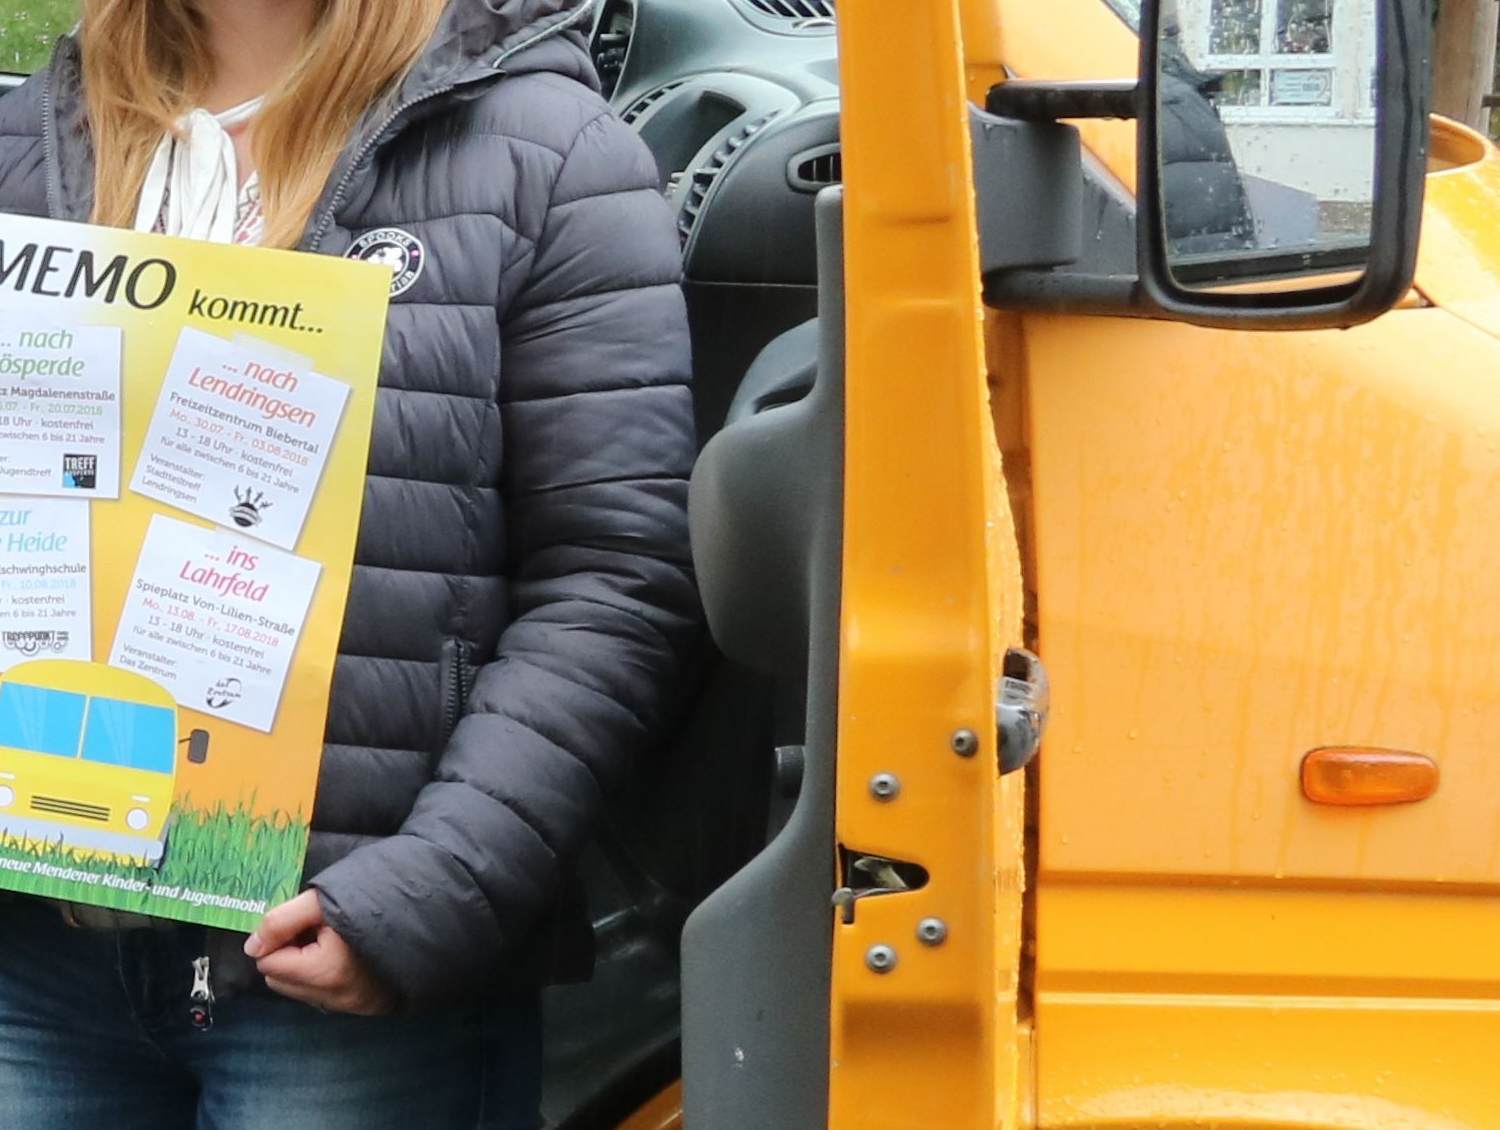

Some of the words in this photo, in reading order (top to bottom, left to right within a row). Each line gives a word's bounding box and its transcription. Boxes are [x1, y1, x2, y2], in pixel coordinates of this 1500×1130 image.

[359, 231, 414, 248] SPOOKS
[187, 288, 325, 333] kommt...
[18, 328, 73, 349] nach
[243, 360, 299, 393] nach
[10, 385, 115, 401] Magdalenenstraße
[186, 366, 316, 430] Lendringsen
[47, 403, 102, 415] 20.07.2018
[169, 391, 263, 434] Freizeitzentrum
[264, 426, 319, 454] Biebertal
[12, 416, 32, 426] Uhr
[40, 417, 93, 430] kostenfrei
[41, 432, 47, 440] 6
[50, 432, 63, 441] bis
[65, 433, 76, 442] 21
[79, 434, 105, 443] Jahre
[64, 455, 95, 470] TREFF
[175, 426, 189, 438] 13
[197, 434, 211, 446] 18
[212, 439, 234, 454] Uhr
[239, 449, 293, 477] kostenfrei
[250, 438, 309, 466] 03.08.2018
[140, 475, 197, 503] Lendringsen
[6, 531, 67, 552] Heide
[225, 544, 259, 571] ins
[178, 559, 269, 604] Lahrfeld
[11, 594, 65, 604] kostenfrei
[135, 578, 190, 604] Spieplatz
[191, 595, 295, 636] Von-Lilien-Straße
[147, 614, 160, 626] 13
[169, 621, 182, 633] 18
[184, 625, 204, 640] Uhr
[211, 634, 264, 658] kostenfrei
[224, 622, 279, 646] 17.08.2018
[118, 654, 136, 667] Das
[137, 660, 177, 680] Zentrum
[32, 861, 99, 884] Mendener
[101, 872, 151, 892] Kinder-
[151, 883, 179, 898] und
[179, 886, 266, 917] Jugendmobil
